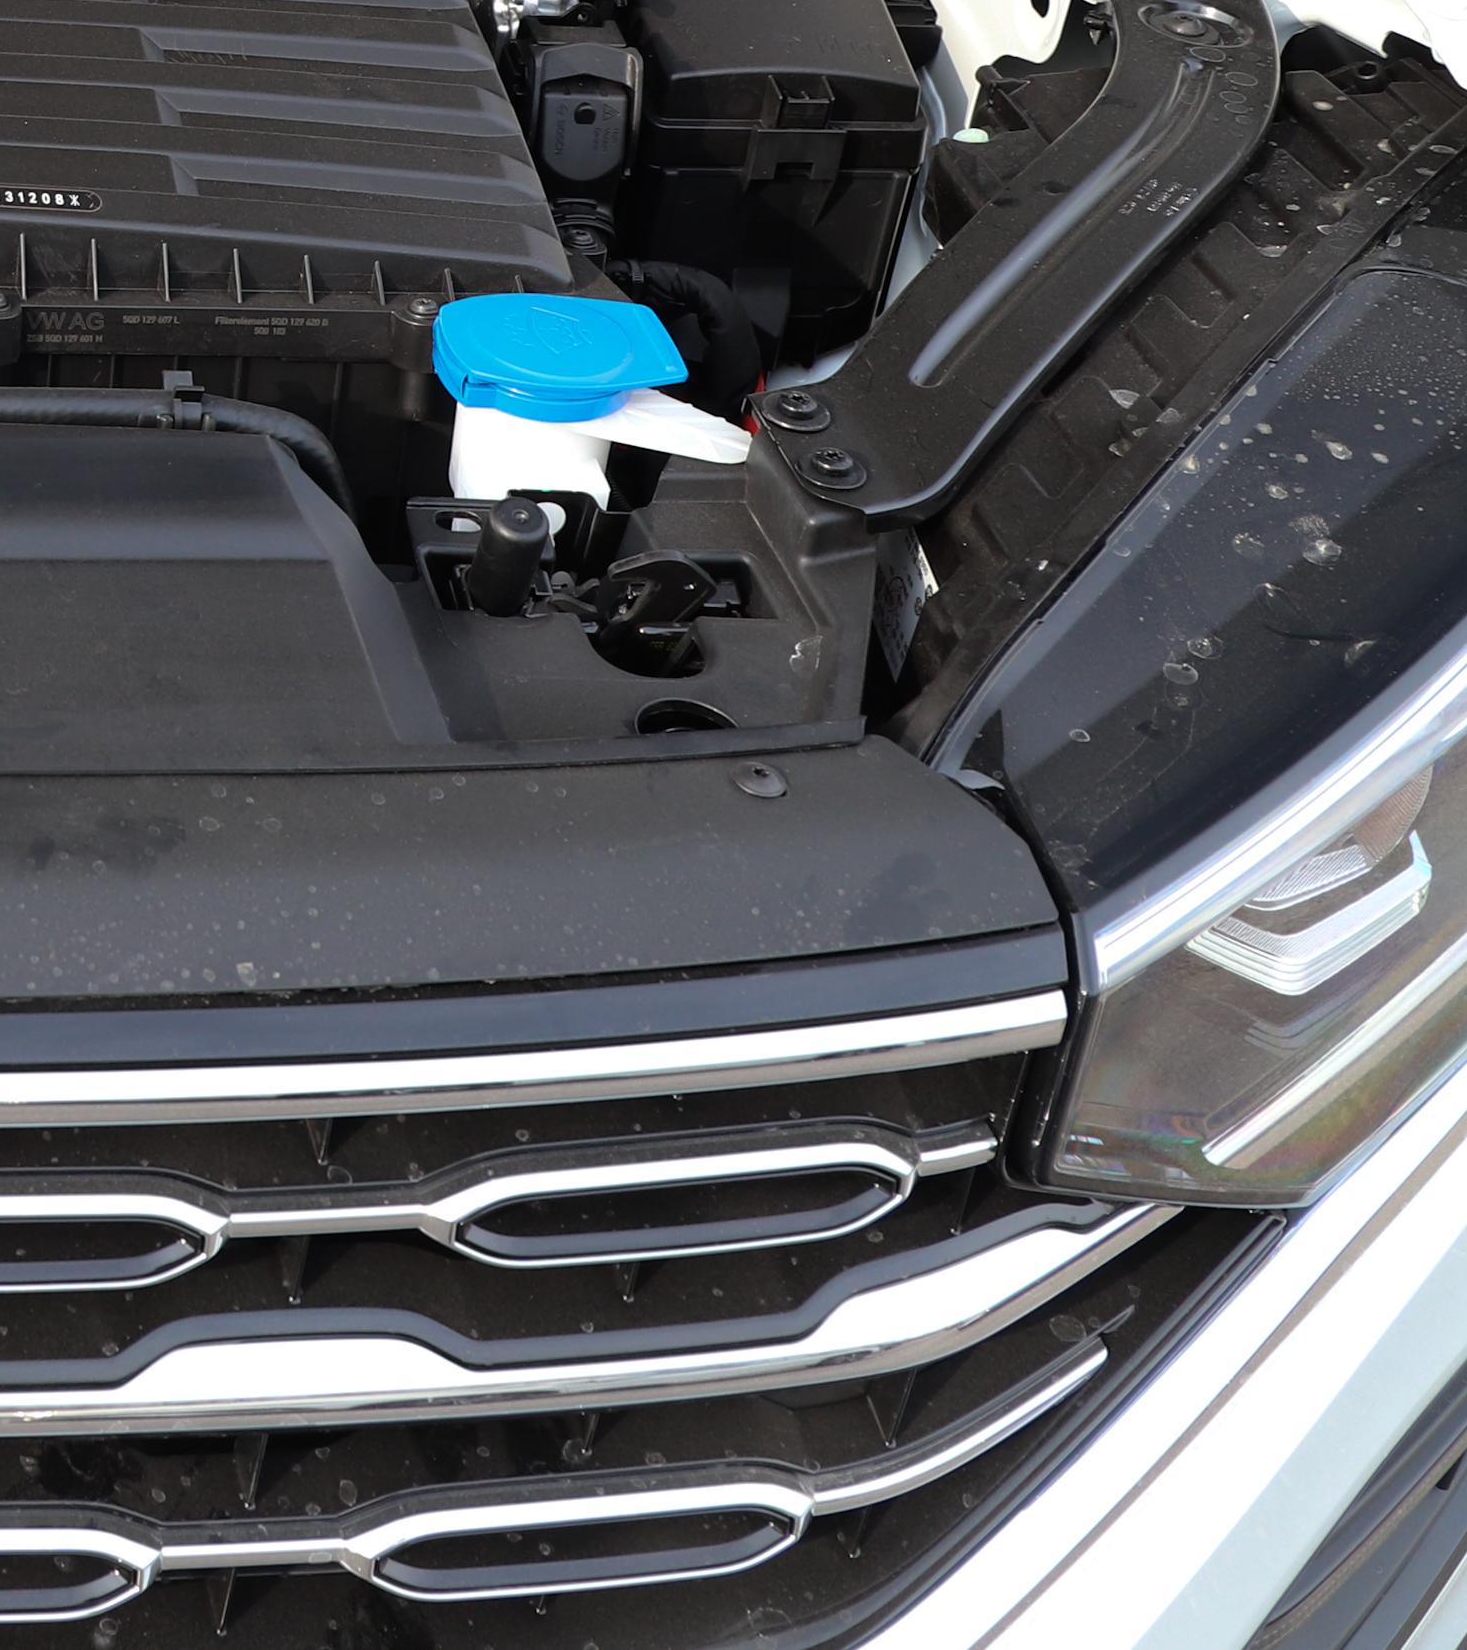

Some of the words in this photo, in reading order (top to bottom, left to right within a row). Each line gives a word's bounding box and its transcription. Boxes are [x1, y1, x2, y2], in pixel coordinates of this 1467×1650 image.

[26, 311, 66, 330] VW
[68, 311, 105, 331] AG
[174, 316, 180, 325] L
